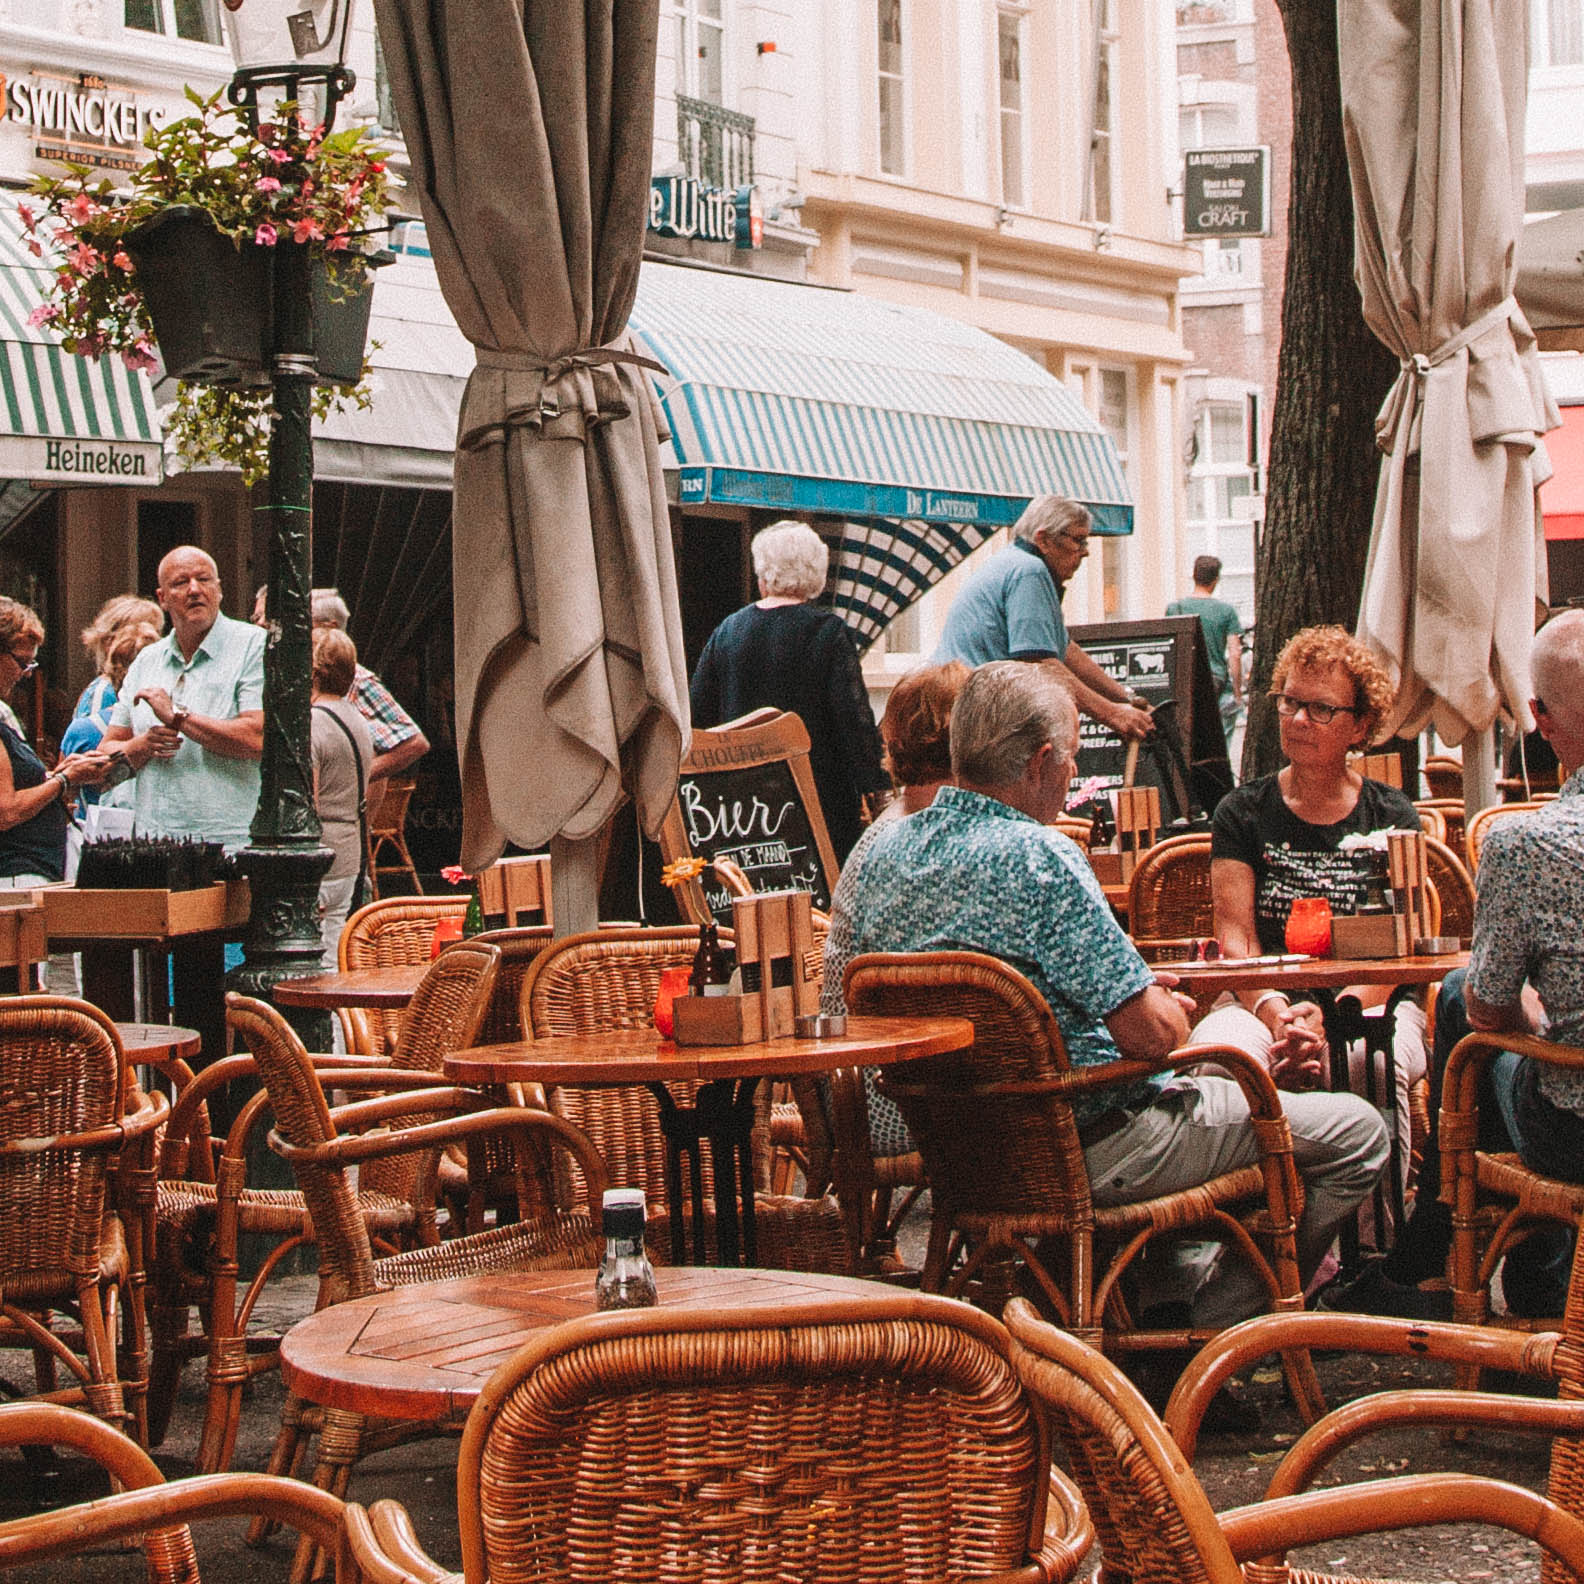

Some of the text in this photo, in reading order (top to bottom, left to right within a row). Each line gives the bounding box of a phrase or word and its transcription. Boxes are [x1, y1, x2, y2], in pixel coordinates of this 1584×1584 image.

[39, 148, 96, 165] SUPERIOR
[669, 177, 737, 240] Witte
[1198, 210, 1248, 227] CRAFT
[44, 440, 146, 476] Heineken
[680, 780, 795, 848] Bier
